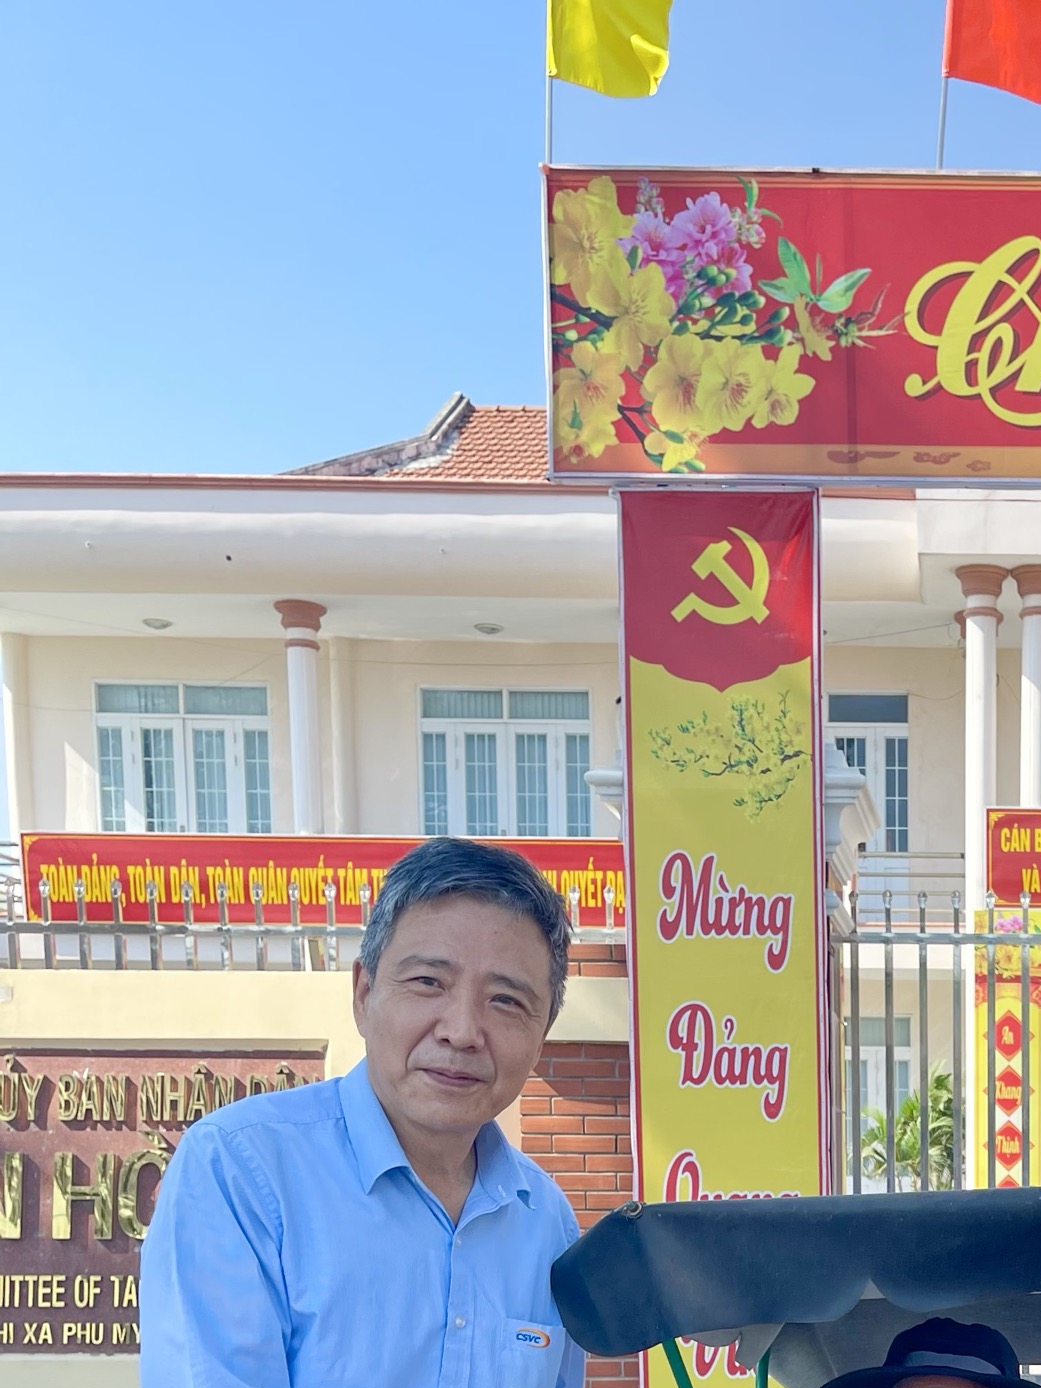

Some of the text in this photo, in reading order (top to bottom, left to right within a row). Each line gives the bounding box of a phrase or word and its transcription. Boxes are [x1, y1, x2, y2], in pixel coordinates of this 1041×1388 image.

[1001, 823, 1030, 853] CÁN
[40, 857, 78, 903] TOÀN
[127, 857, 167, 904] TOÀN
[169, 858, 206, 909] DÂN,
[206, 859, 246, 905] TOÀN
[337, 861, 371, 906] TÂM
[1022, 863, 1041, 893] VÀ
[659, 851, 793, 971] Mừng
[1001, 1026, 1015, 1045] An
[667, 1002, 789, 1121] Đảng
[57, 1073, 127, 1122] BAN
[139, 1062, 236, 1122] NHÂN
[995, 1081, 1022, 1105] Khang
[996, 1135, 1020, 1158] Thịnh
[52, 1130, 172, 1240] HÒ
[0, 1275, 140, 1308] ITTEE OF TA
[23, 1322, 53, 1345] XA
[62, 1322, 104, 1345] PHU
